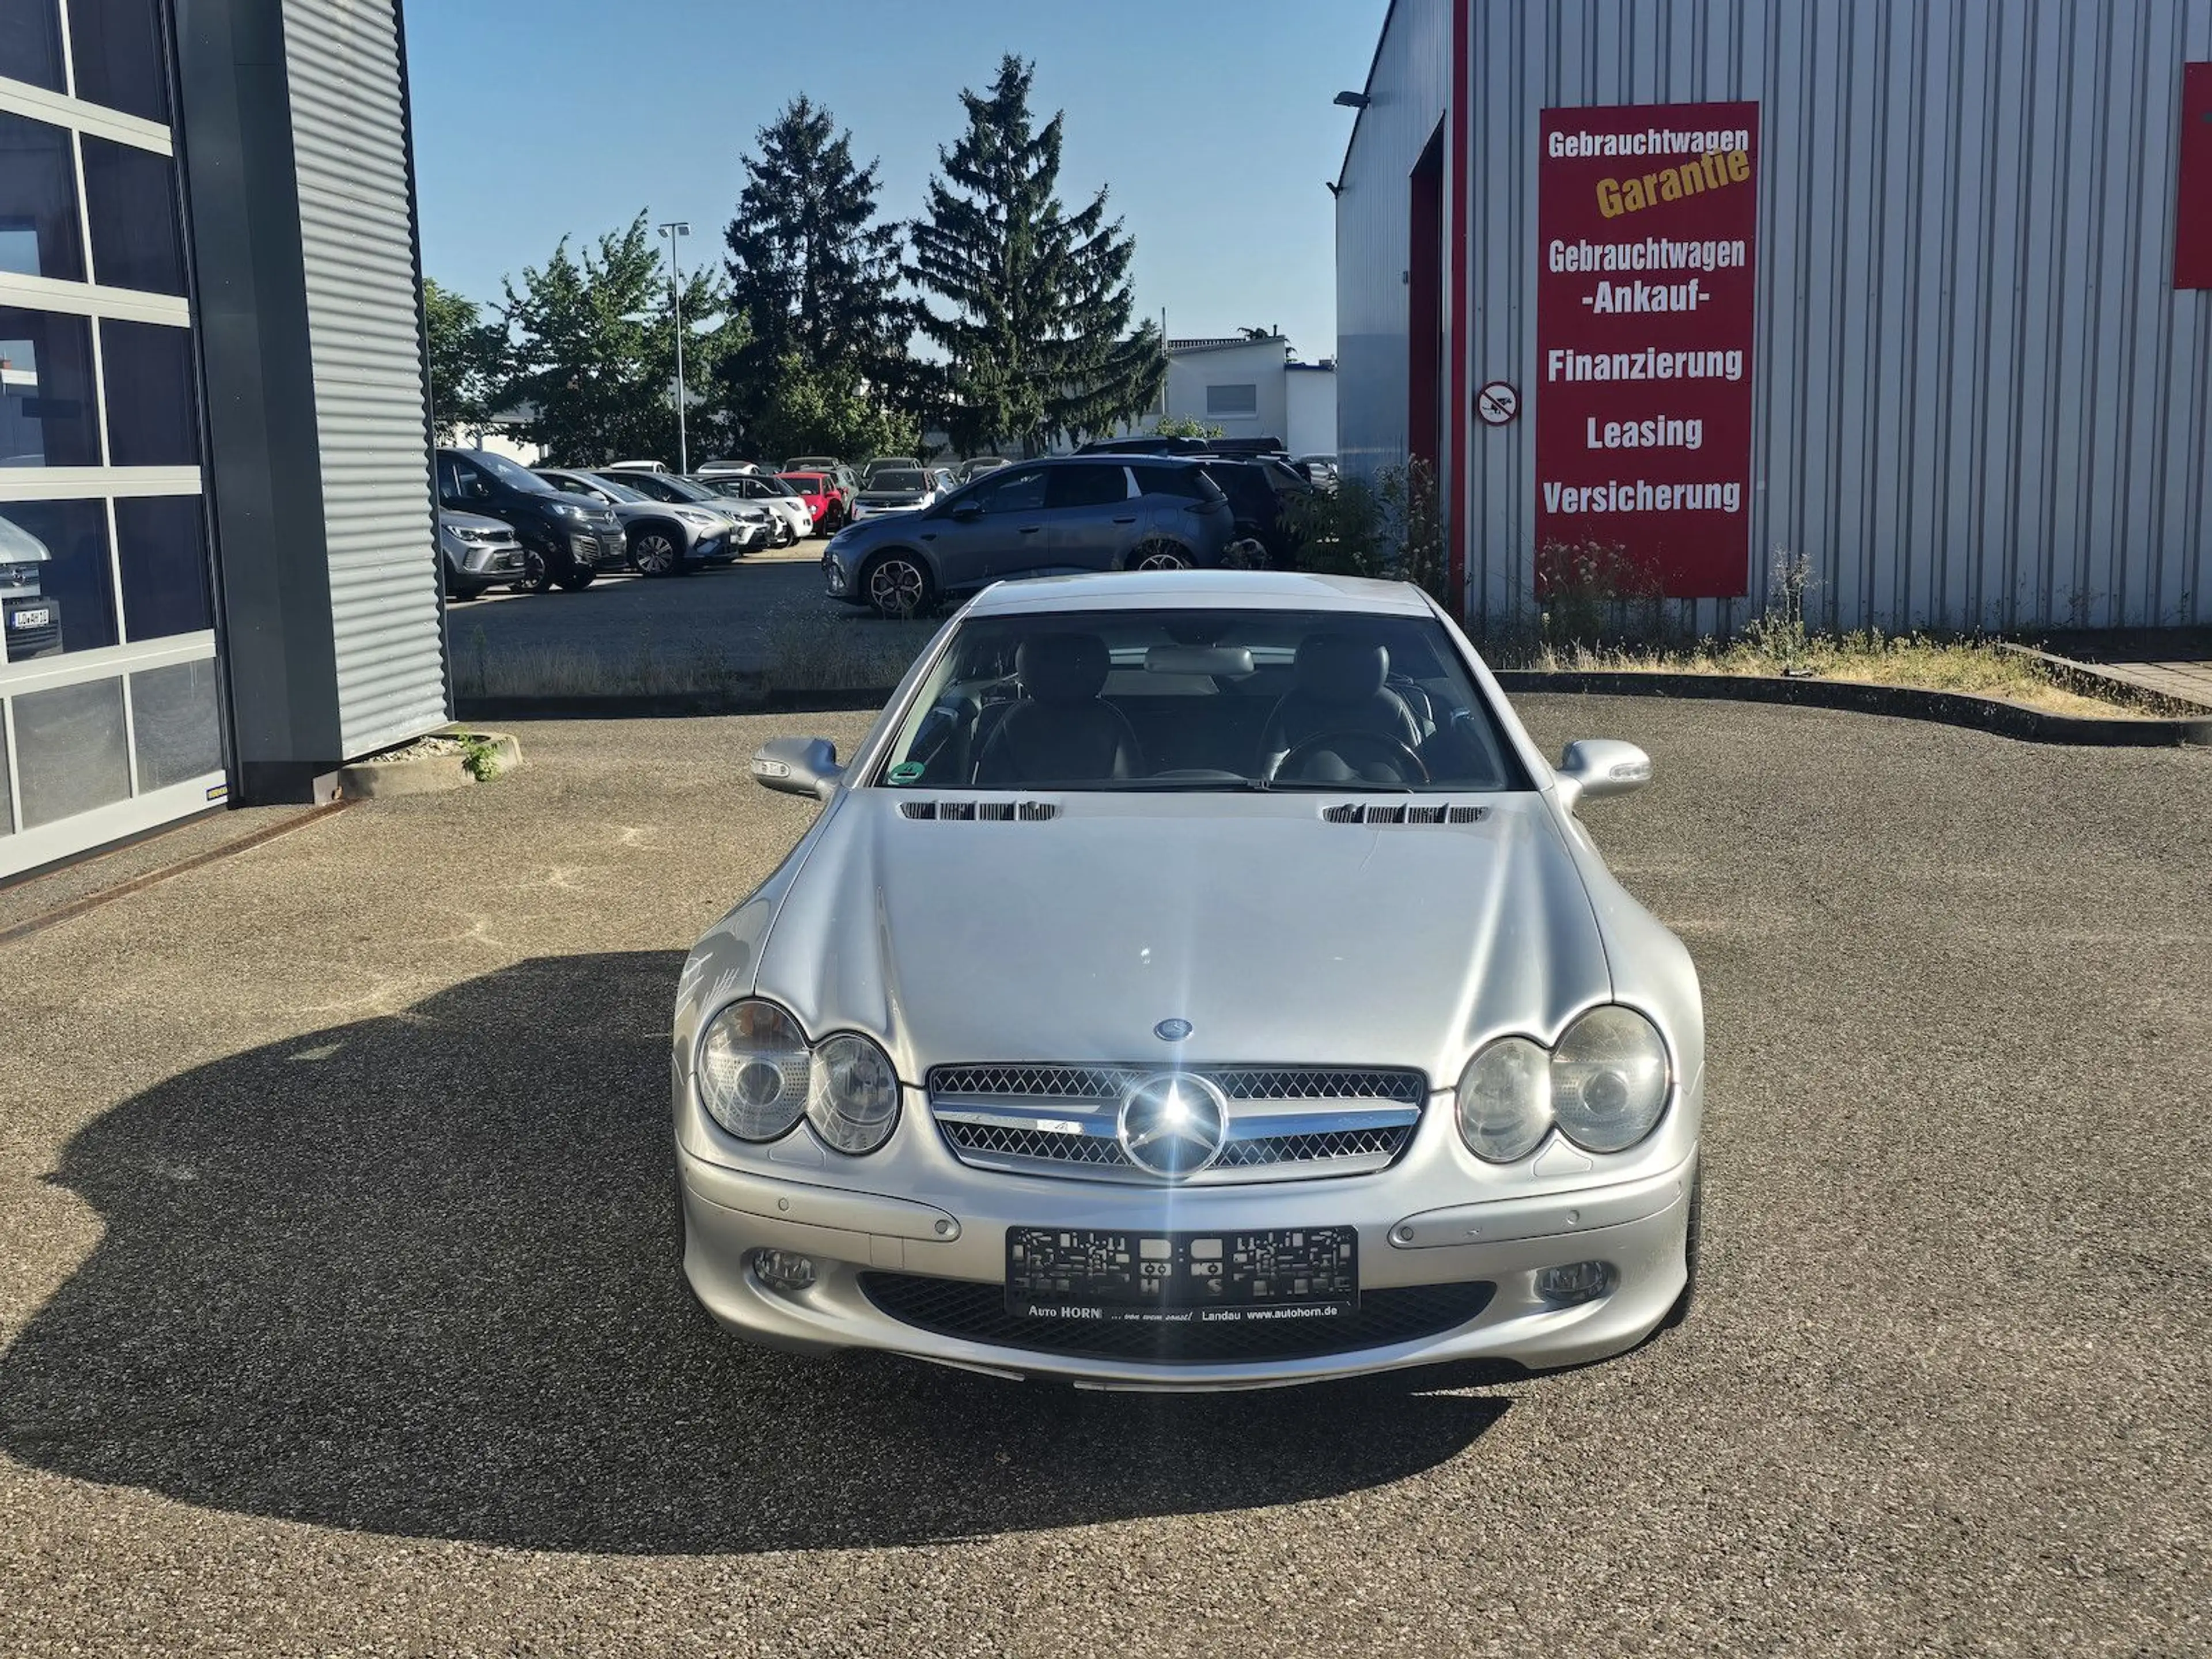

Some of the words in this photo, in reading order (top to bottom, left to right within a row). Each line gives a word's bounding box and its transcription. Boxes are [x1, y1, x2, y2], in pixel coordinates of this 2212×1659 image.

[1548, 128, 1748, 158] Gebrauchtwagen
[1597, 147, 1749, 218] Garantie
[1550, 237, 1745, 272] Gebrauchtwagen
[1582, 278, 1710, 313] -Ankauf-
[1548, 347, 1743, 381] Finanzierung
[1587, 415, 1702, 449] Leasing
[1543, 480, 1740, 513] Versicherung
[1061, 1306, 1103, 1319] HORN
[1202, 1310, 1241, 1321] Landau
[1247, 1306, 1338, 1320] www.autohorn.de
